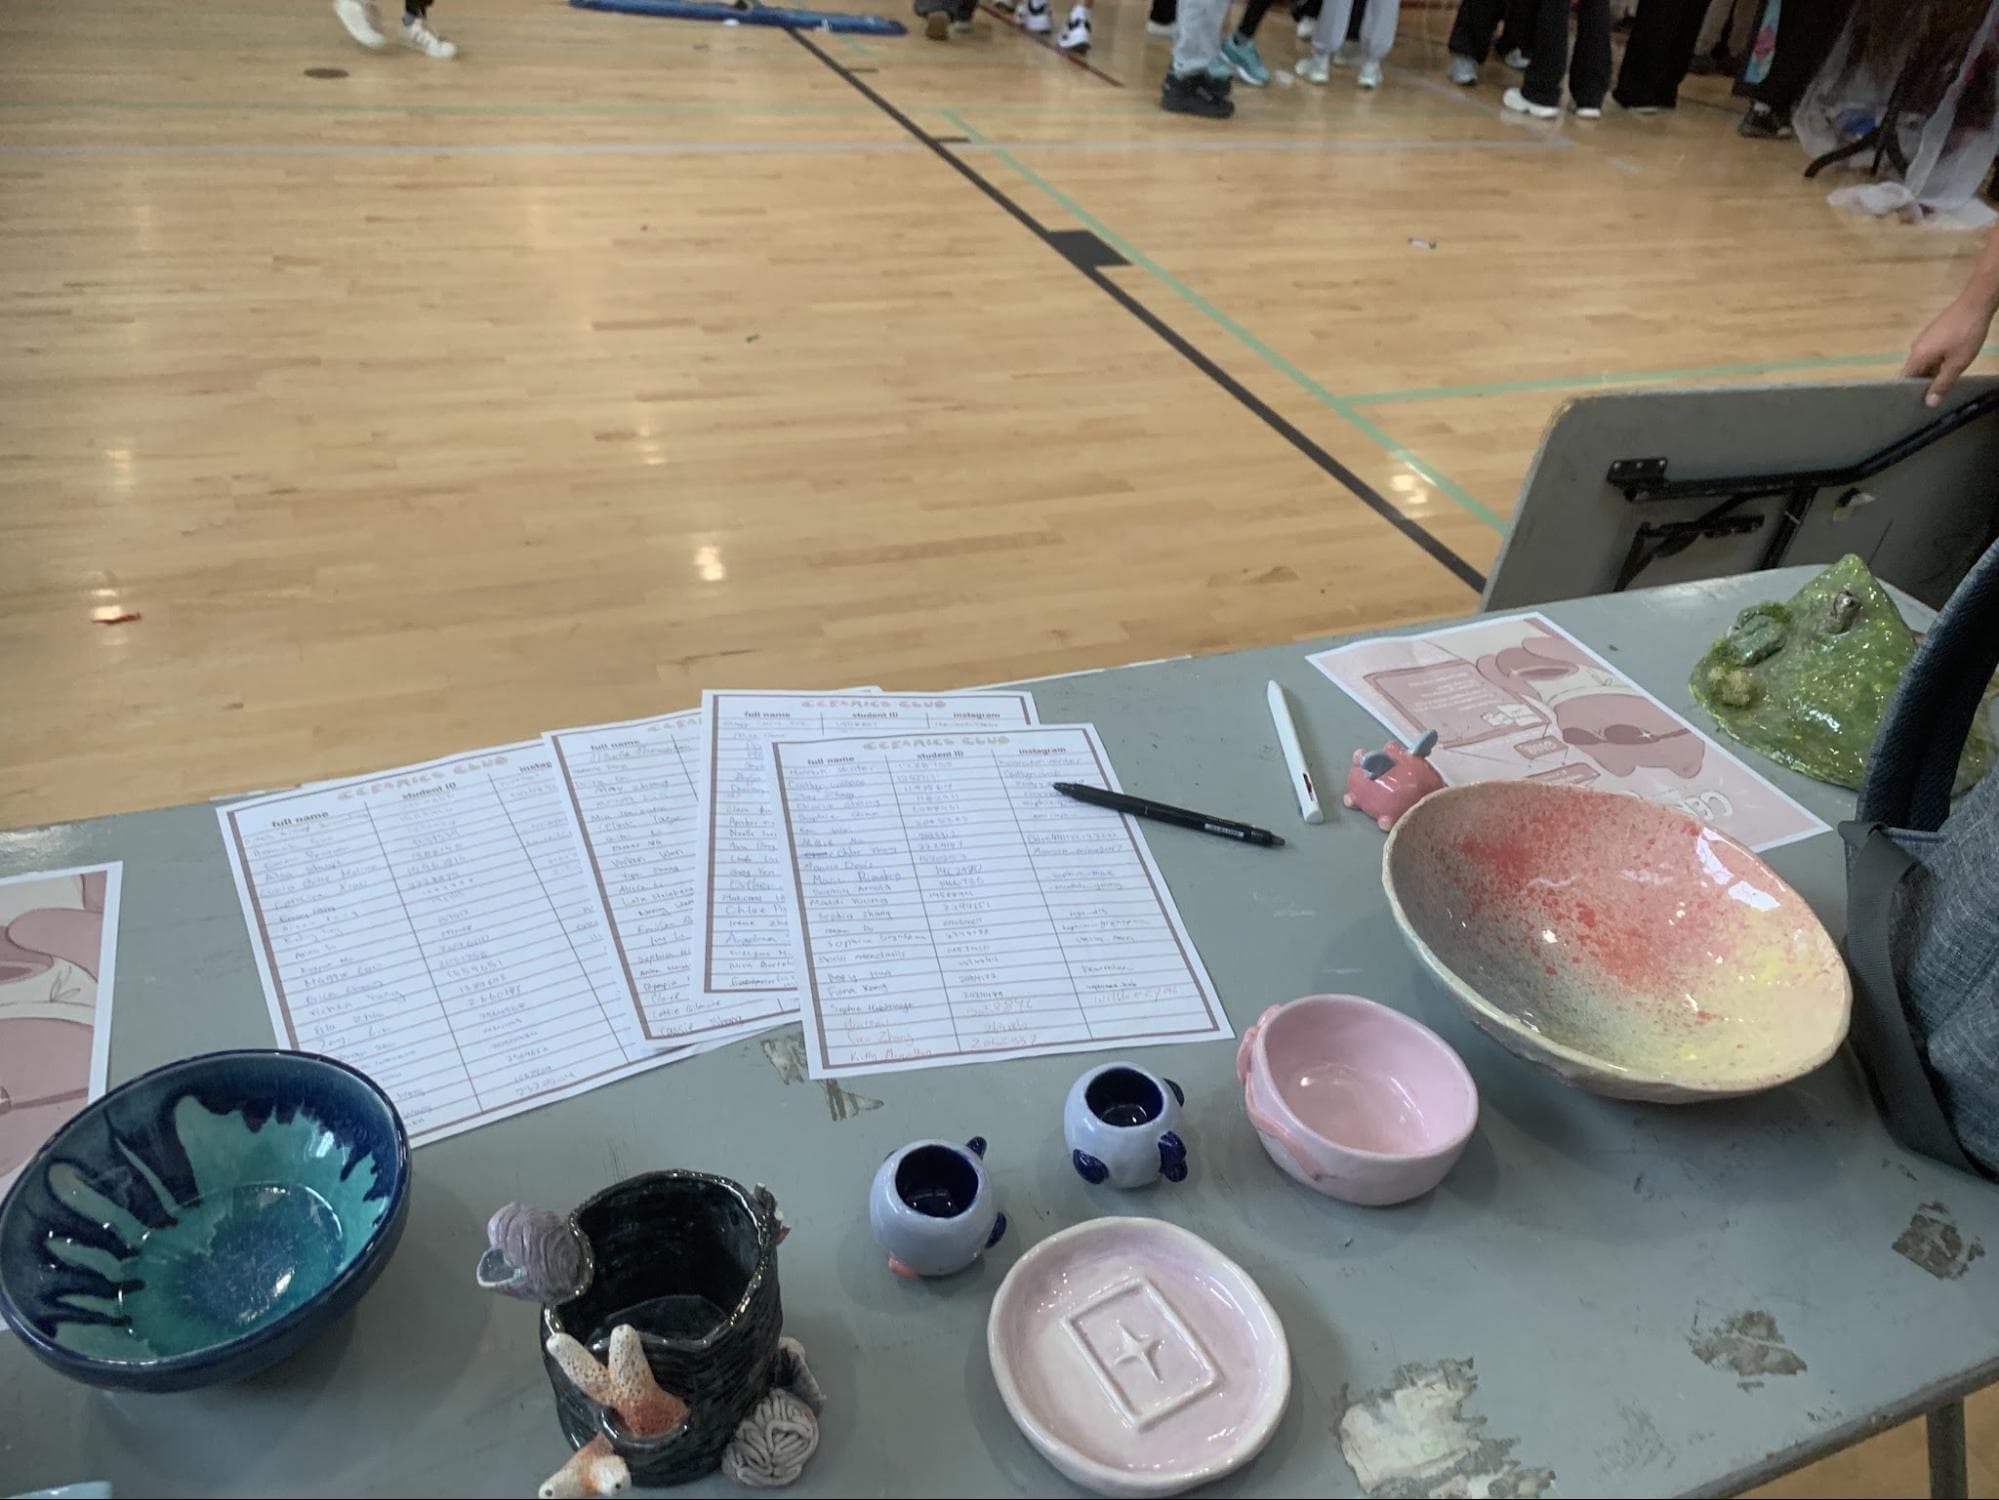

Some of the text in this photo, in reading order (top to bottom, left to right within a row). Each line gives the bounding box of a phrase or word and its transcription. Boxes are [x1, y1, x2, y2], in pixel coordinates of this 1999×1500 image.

[852, 711, 899, 720] student ID
[953, 711, 1000, 721] instagram
[590, 740, 640, 752] full name
[1018, 746, 1067, 756] instagram
[916, 750, 964, 761] student ID
[807, 756, 855, 767] full name
[402, 781, 458, 801] student ID
[271, 810, 330, 829] full name
